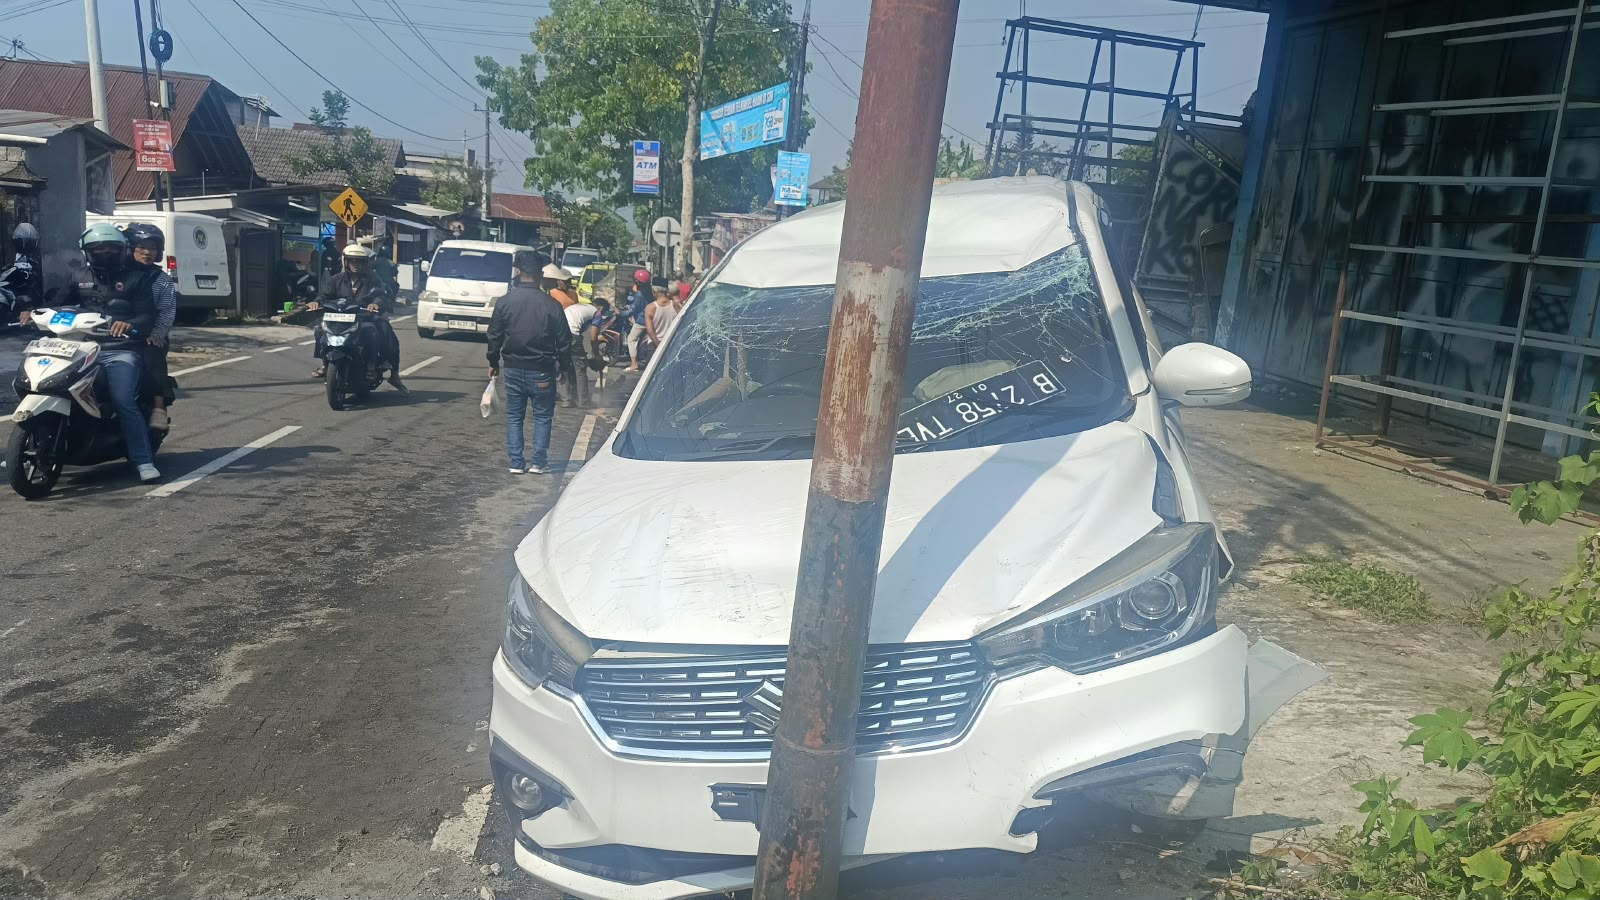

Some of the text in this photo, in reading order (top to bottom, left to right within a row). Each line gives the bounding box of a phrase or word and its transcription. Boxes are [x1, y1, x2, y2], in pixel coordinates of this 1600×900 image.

[636, 161, 657, 169] ATM
[947, 383, 988, 404] 01 27
[1032, 373, 1058, 394] B
